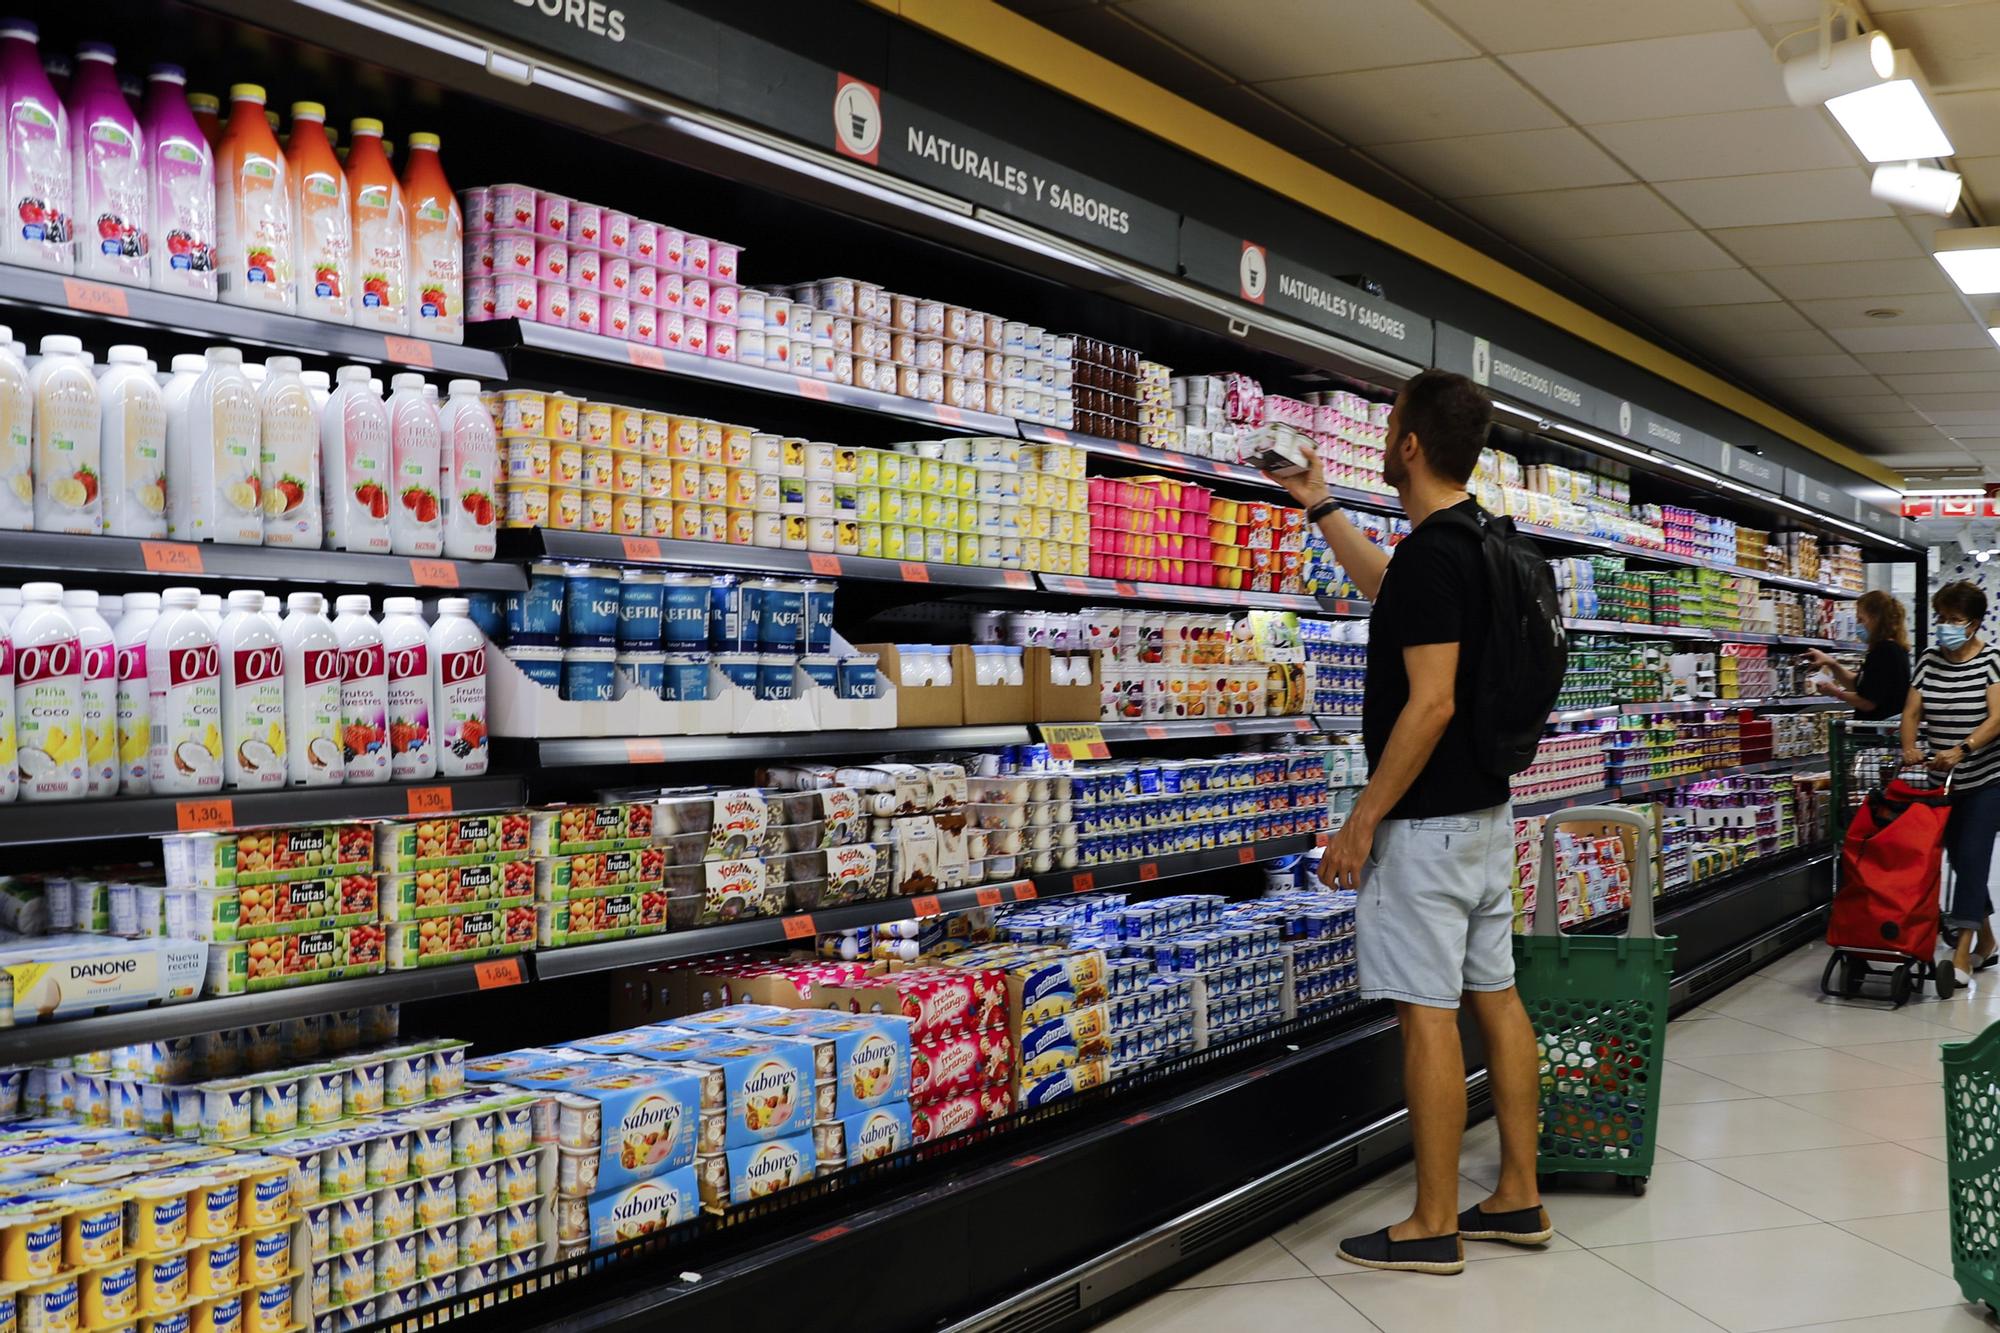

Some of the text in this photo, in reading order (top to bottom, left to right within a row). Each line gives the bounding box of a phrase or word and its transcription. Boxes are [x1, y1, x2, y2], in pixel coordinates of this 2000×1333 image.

[513, 0, 626, 43] ORES
[908, 126, 1130, 235] NATURALES Y SABORES
[1279, 274, 1406, 340] NATURALES Y SABORES
[1493, 359, 1549, 394] ENRIQUECIDOS
[1553, 384, 1582, 407] CREMAS
[620, 606, 659, 622] KEFIR
[35, 686, 66, 697] Piña
[31, 707, 69, 717] Coco
[188, 808, 222, 822] 1,30€
[596, 815, 618, 825] frutas
[461, 827, 488, 838] frutas
[291, 837, 323, 850] frutas
[607, 860, 630, 871] frutas
[462, 875, 490, 886] frutas
[292, 889, 325, 903] frutas
[606, 903, 630, 914] frutas
[464, 921, 492, 933] frutas
[300, 940, 333, 954] frutas
[167, 953, 200, 963] Nueva
[168, 962, 199, 972] receta
[1035, 970, 1067, 999] natural
[933, 988, 955, 1007] fresa
[1035, 1024, 1069, 1054] natural
[851, 1041, 896, 1066] sabores
[941, 1046, 962, 1066] fresa
[936, 1052, 973, 1086] morango
[744, 1068, 797, 1095] sabores
[622, 1102, 681, 1132] sabores
[942, 1103, 963, 1124] fresa
[860, 1119, 899, 1146] sabores
[747, 1153, 798, 1180] sabores
[256, 1182, 287, 1196] Natural
[613, 1191, 677, 1222] sabores
[80, 1219, 119, 1233] Natural
[256, 1238, 287, 1252] Natural
[259, 1289, 290, 1304] Natural
